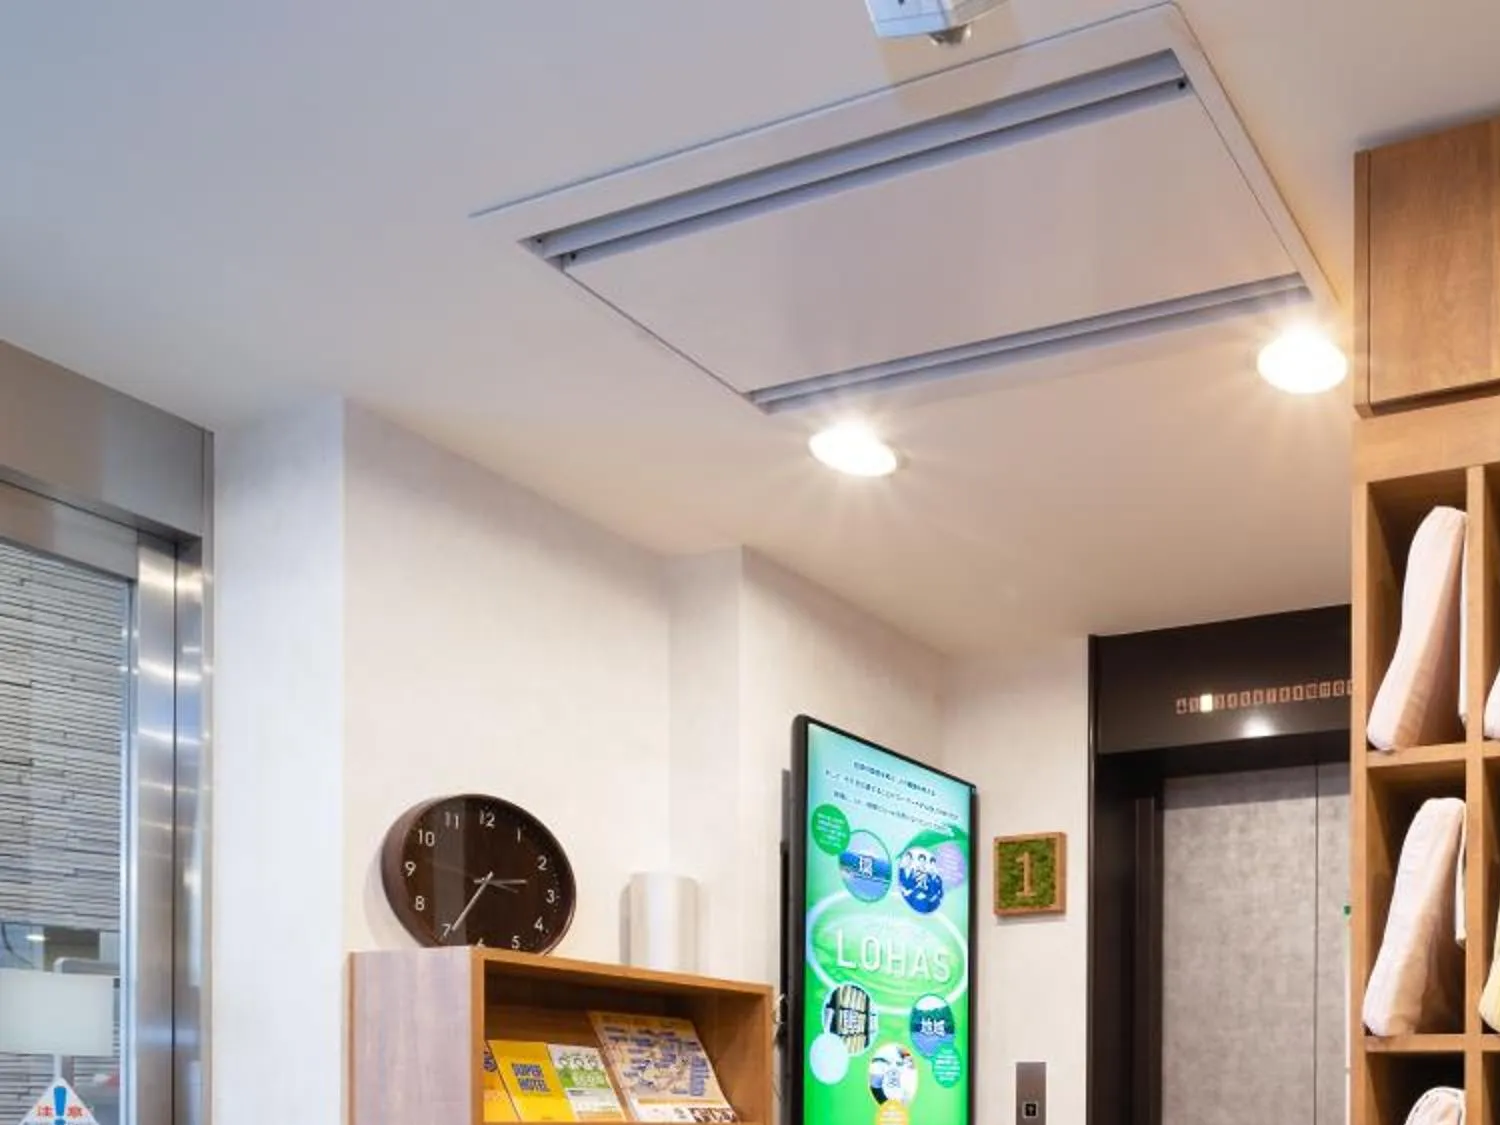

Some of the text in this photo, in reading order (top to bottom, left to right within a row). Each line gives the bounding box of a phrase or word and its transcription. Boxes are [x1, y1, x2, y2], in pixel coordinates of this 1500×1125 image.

[445, 812, 459, 829] 11
[479, 810, 496, 828] 12
[418, 829, 435, 847] 10
[405, 861, 416, 876] 9
[537, 855, 548, 870] 2
[1015, 852, 1037, 897] 1
[414, 896, 425, 911] 8
[545, 889, 555, 904] 3
[442, 924, 452, 937] 7
[533, 917, 544, 931] 4
[511, 935, 520, 949] 5
[834, 929, 952, 983] LOHAS
